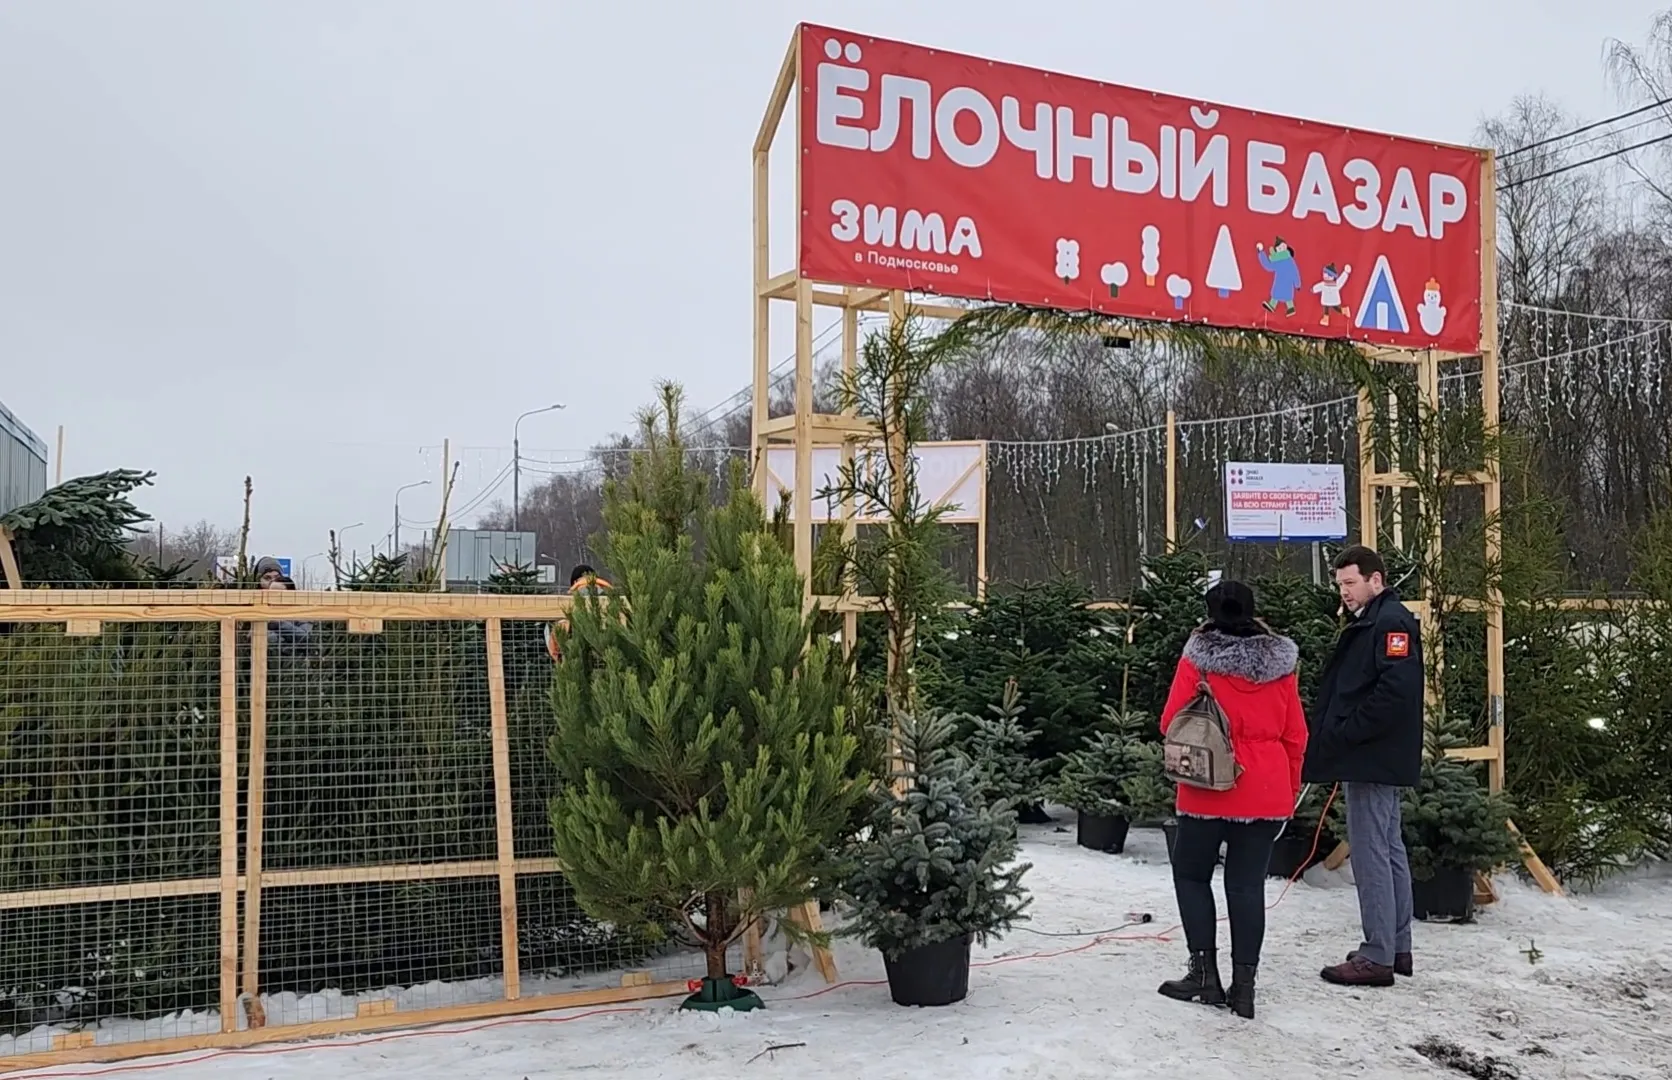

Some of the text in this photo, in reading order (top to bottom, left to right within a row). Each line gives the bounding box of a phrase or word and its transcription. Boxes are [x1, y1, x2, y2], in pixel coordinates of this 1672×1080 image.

[816, 38, 1467, 240] ЁЛОЧНЫЙ БАЗАР
[830, 199, 982, 259] ЗИМА
[854, 251, 959, 275] в Подмосковье
[1243, 501, 1259, 509] ВСЮ
[1262, 492, 1268, 500] О
